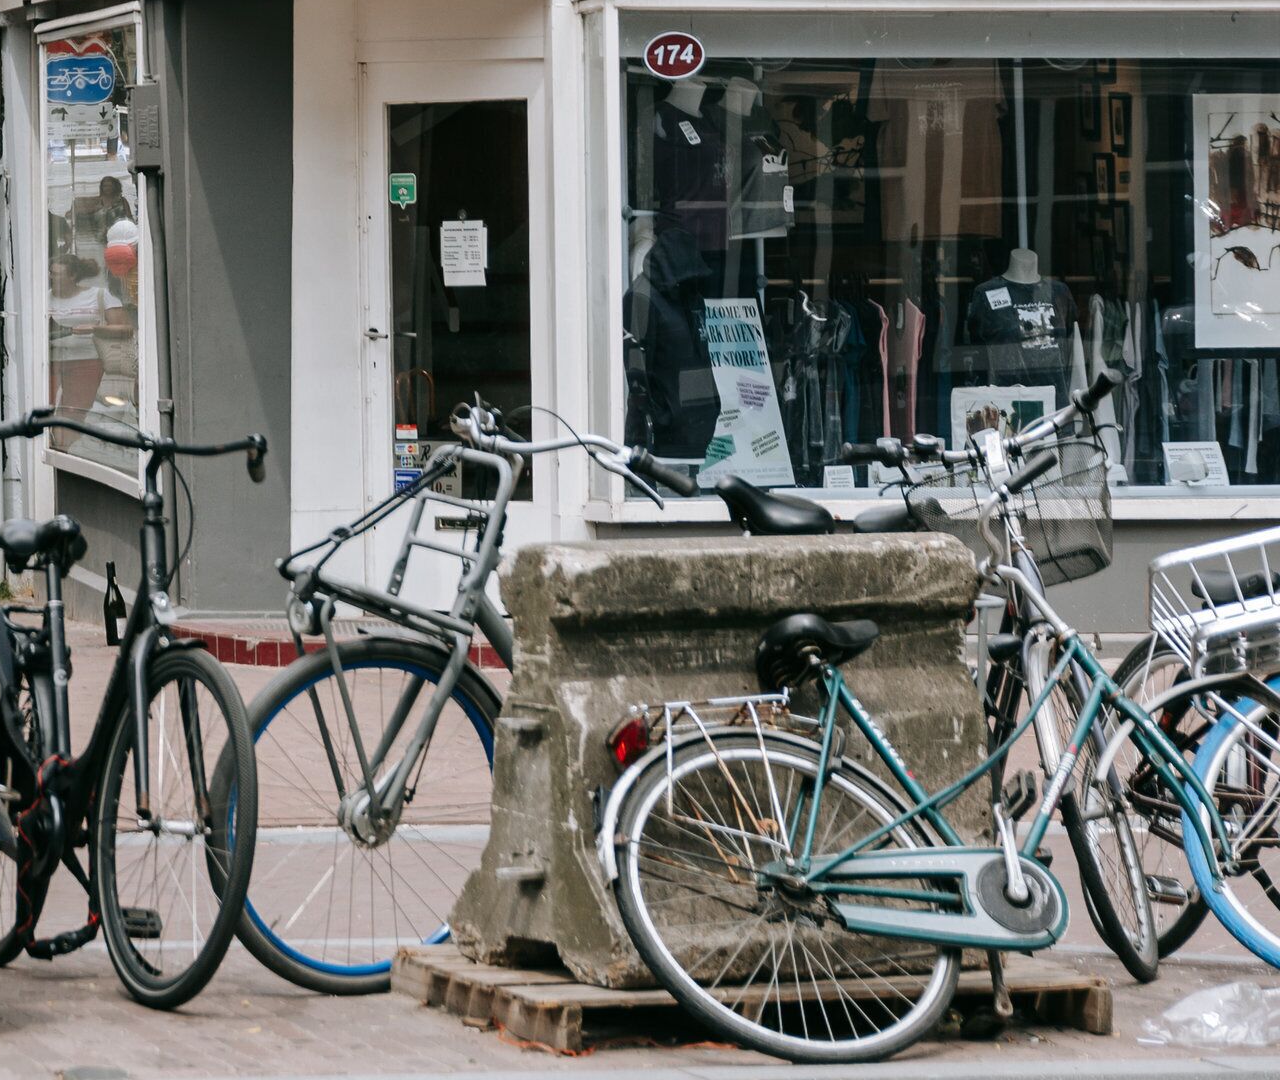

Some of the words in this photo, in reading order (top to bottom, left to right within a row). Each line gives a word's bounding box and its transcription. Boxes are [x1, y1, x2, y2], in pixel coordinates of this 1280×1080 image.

[653, 44, 694, 66] 174
[706, 305, 740, 319] LCOME
[742, 304, 757, 318] TO
[710, 350, 722, 367] RT
